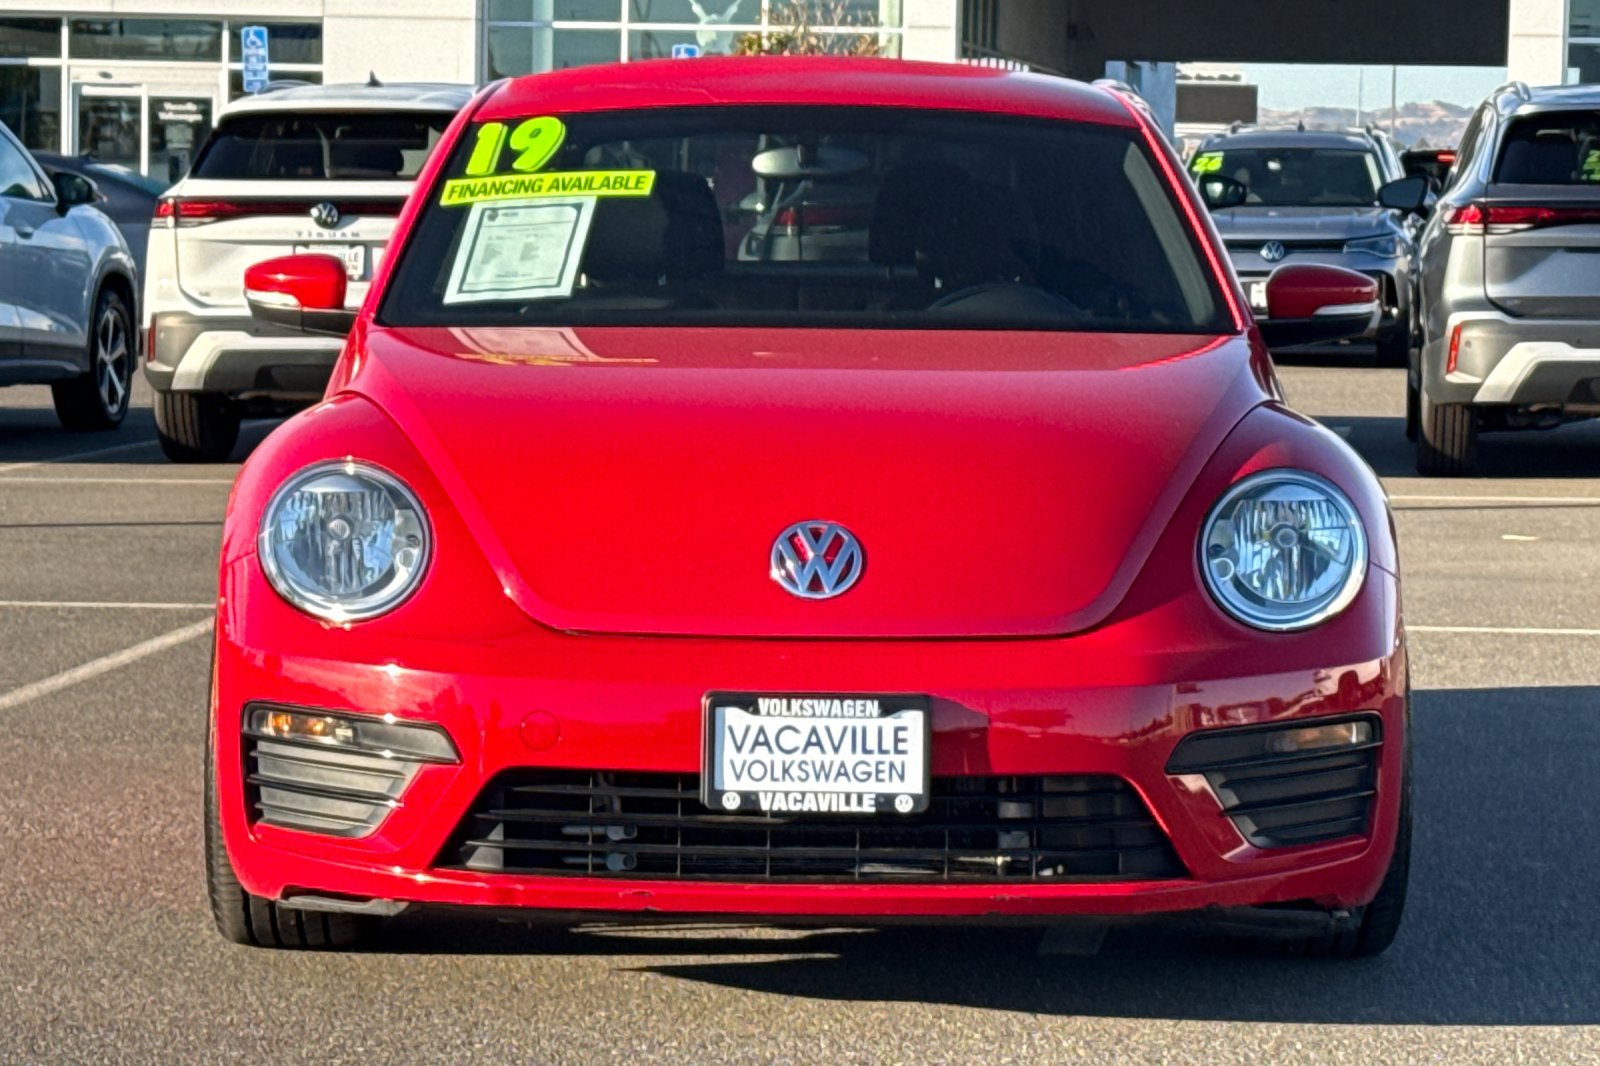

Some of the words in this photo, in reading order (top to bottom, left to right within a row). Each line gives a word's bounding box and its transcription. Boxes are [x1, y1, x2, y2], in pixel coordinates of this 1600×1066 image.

[465, 115, 566, 175] 19
[447, 178, 545, 199] FINANCING
[546, 175, 647, 193] AVAILABLE
[757, 697, 879, 718] VOLKSWAGEN
[727, 724, 909, 755] VACAVILLE
[729, 759, 906, 783] VOLKSWAGEN
[758, 791, 876, 812] VACAVILLE
